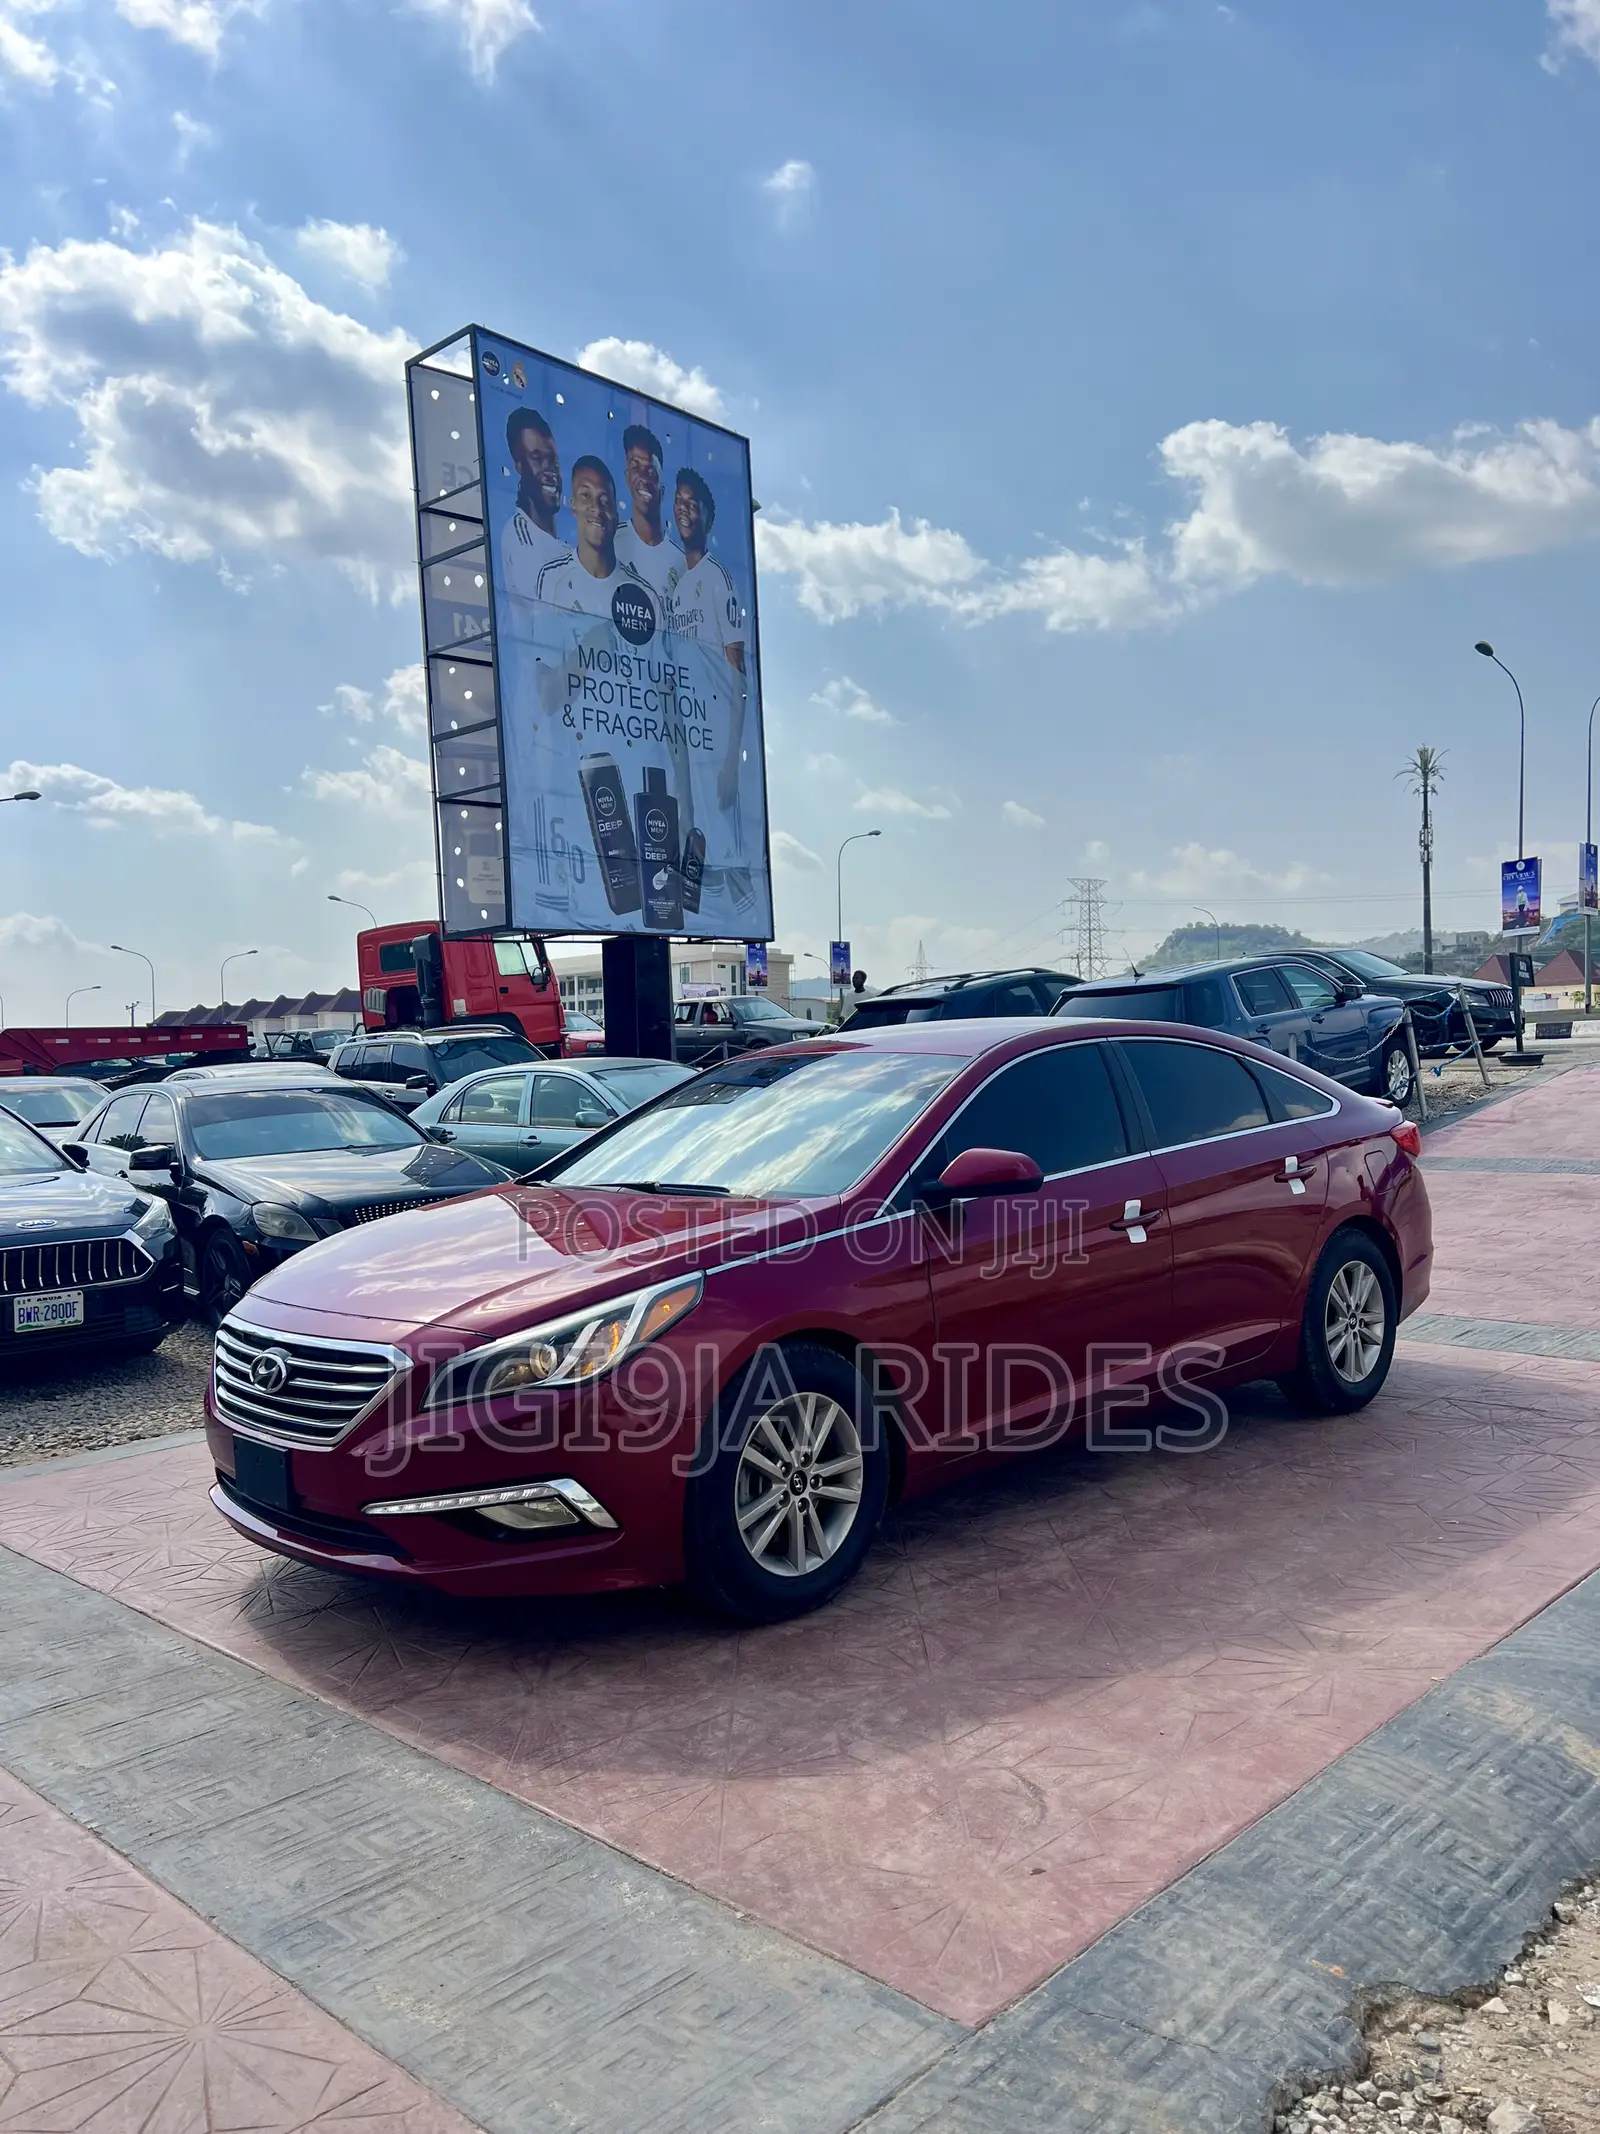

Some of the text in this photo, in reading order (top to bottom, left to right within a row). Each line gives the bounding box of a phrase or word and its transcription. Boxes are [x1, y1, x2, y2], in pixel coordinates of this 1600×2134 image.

[615, 600, 653, 621] NIVEA
[621, 616, 648, 632] MEN
[578, 644, 696, 694] MOISTURE,
[567, 672, 707, 721] PROTECTION
[562, 703, 714, 751] & FRAGRANCE
[598, 820, 623, 832] DEEP
[648, 819, 666, 828] NIVEA
[645, 851, 667, 861] DEEP
